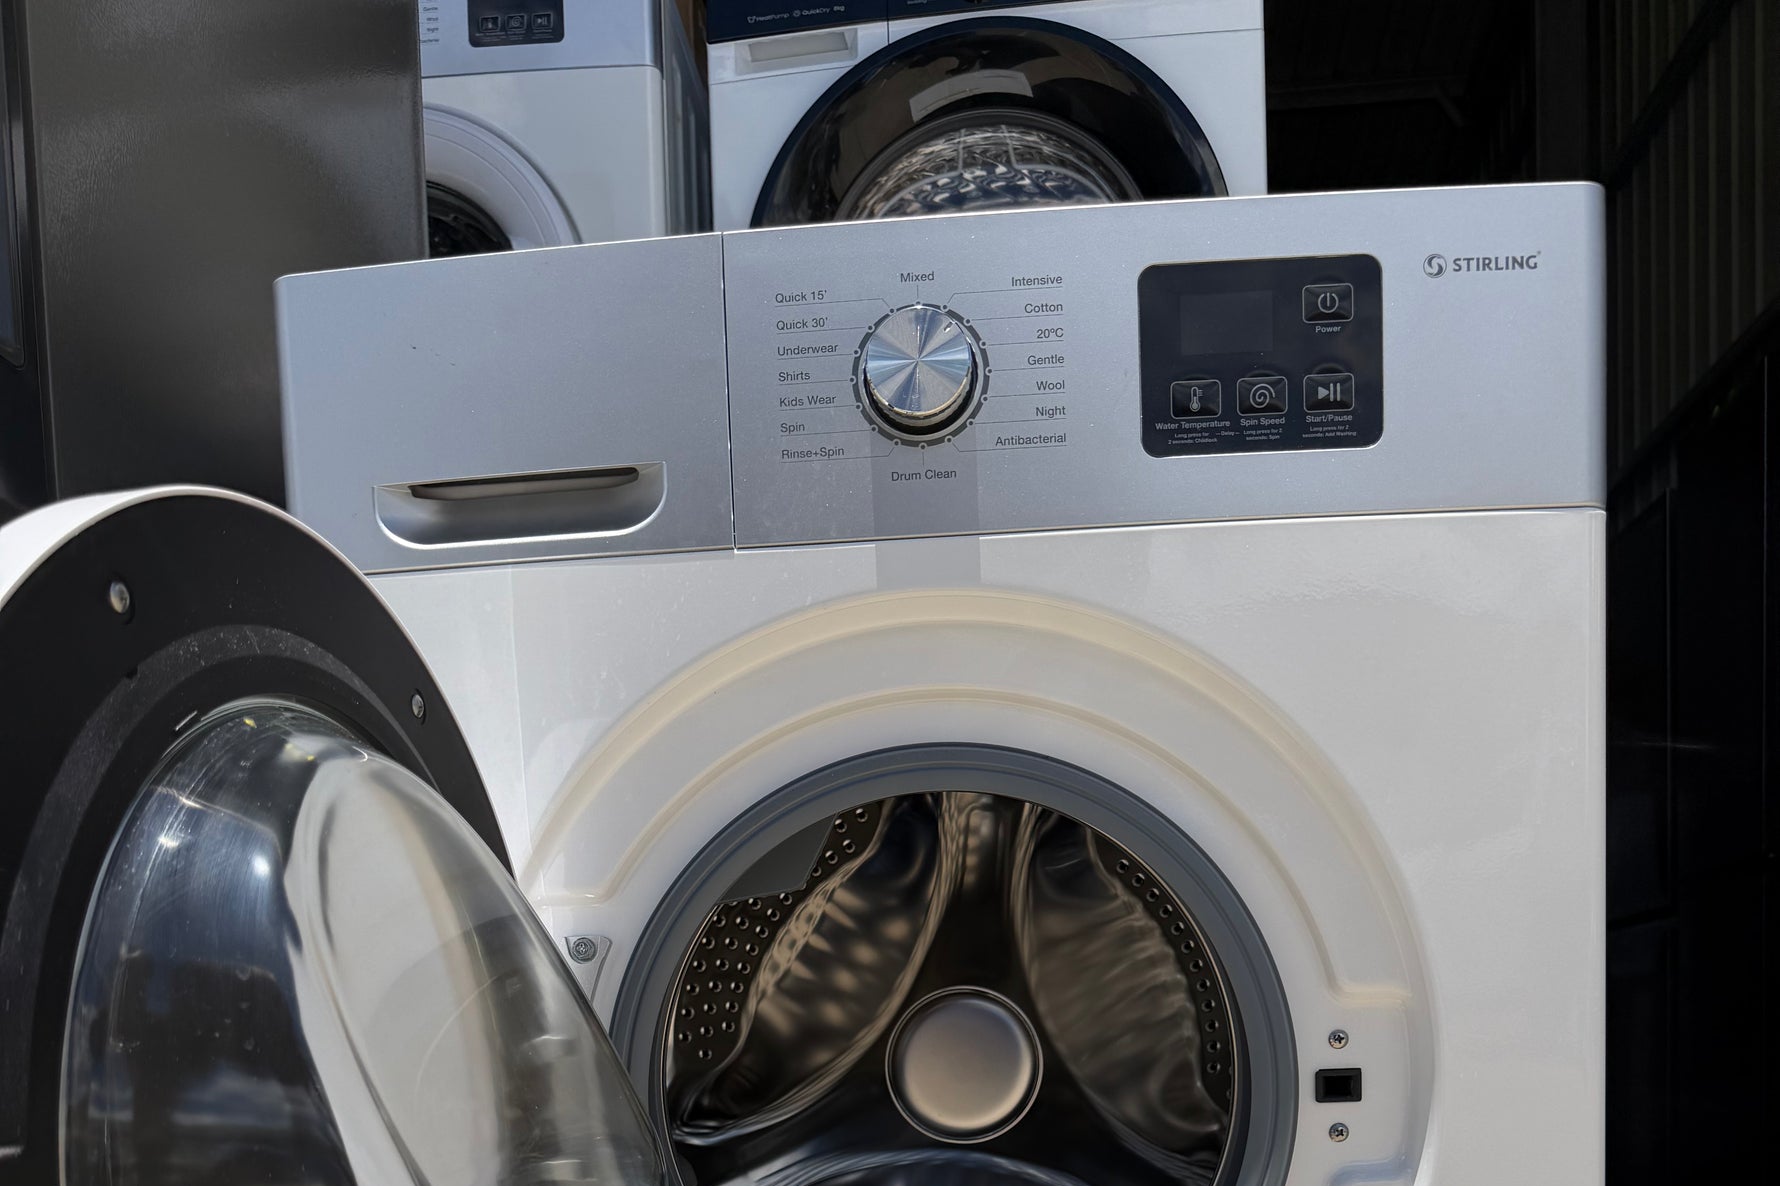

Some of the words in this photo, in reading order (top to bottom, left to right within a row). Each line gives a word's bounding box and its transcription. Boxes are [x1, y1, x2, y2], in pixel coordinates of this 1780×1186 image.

[1452, 255, 1538, 272] STIRLING
[900, 271, 934, 282] Mixed
[1011, 275, 1062, 287] Intensive
[775, 292, 807, 304] Quick
[1024, 302, 1063, 314] Cotton
[776, 319, 809, 331] Quick
[1315, 325, 1341, 333] Power
[777, 343, 838, 356] Underwear
[1027, 354, 1065, 365] Gentle
[778, 371, 810, 382] Shirts
[1036, 380, 1065, 391] Wool
[779, 397, 804, 407] Kids
[807, 394, 836, 405] Wear
[1035, 406, 1066, 418] Night
[1306, 414, 1352, 422] Start/Pause
[780, 422, 805, 434] Spin
[1180, 421, 1230, 429] Temperature
[1240, 419, 1258, 427] Spin
[1260, 417, 1285, 426] Speed
[996, 433, 1066, 446] Antibacterial
[781, 447, 845, 461] Rinse+Spin
[891, 470, 921, 481] Drum
[925, 468, 957, 480] Clean
